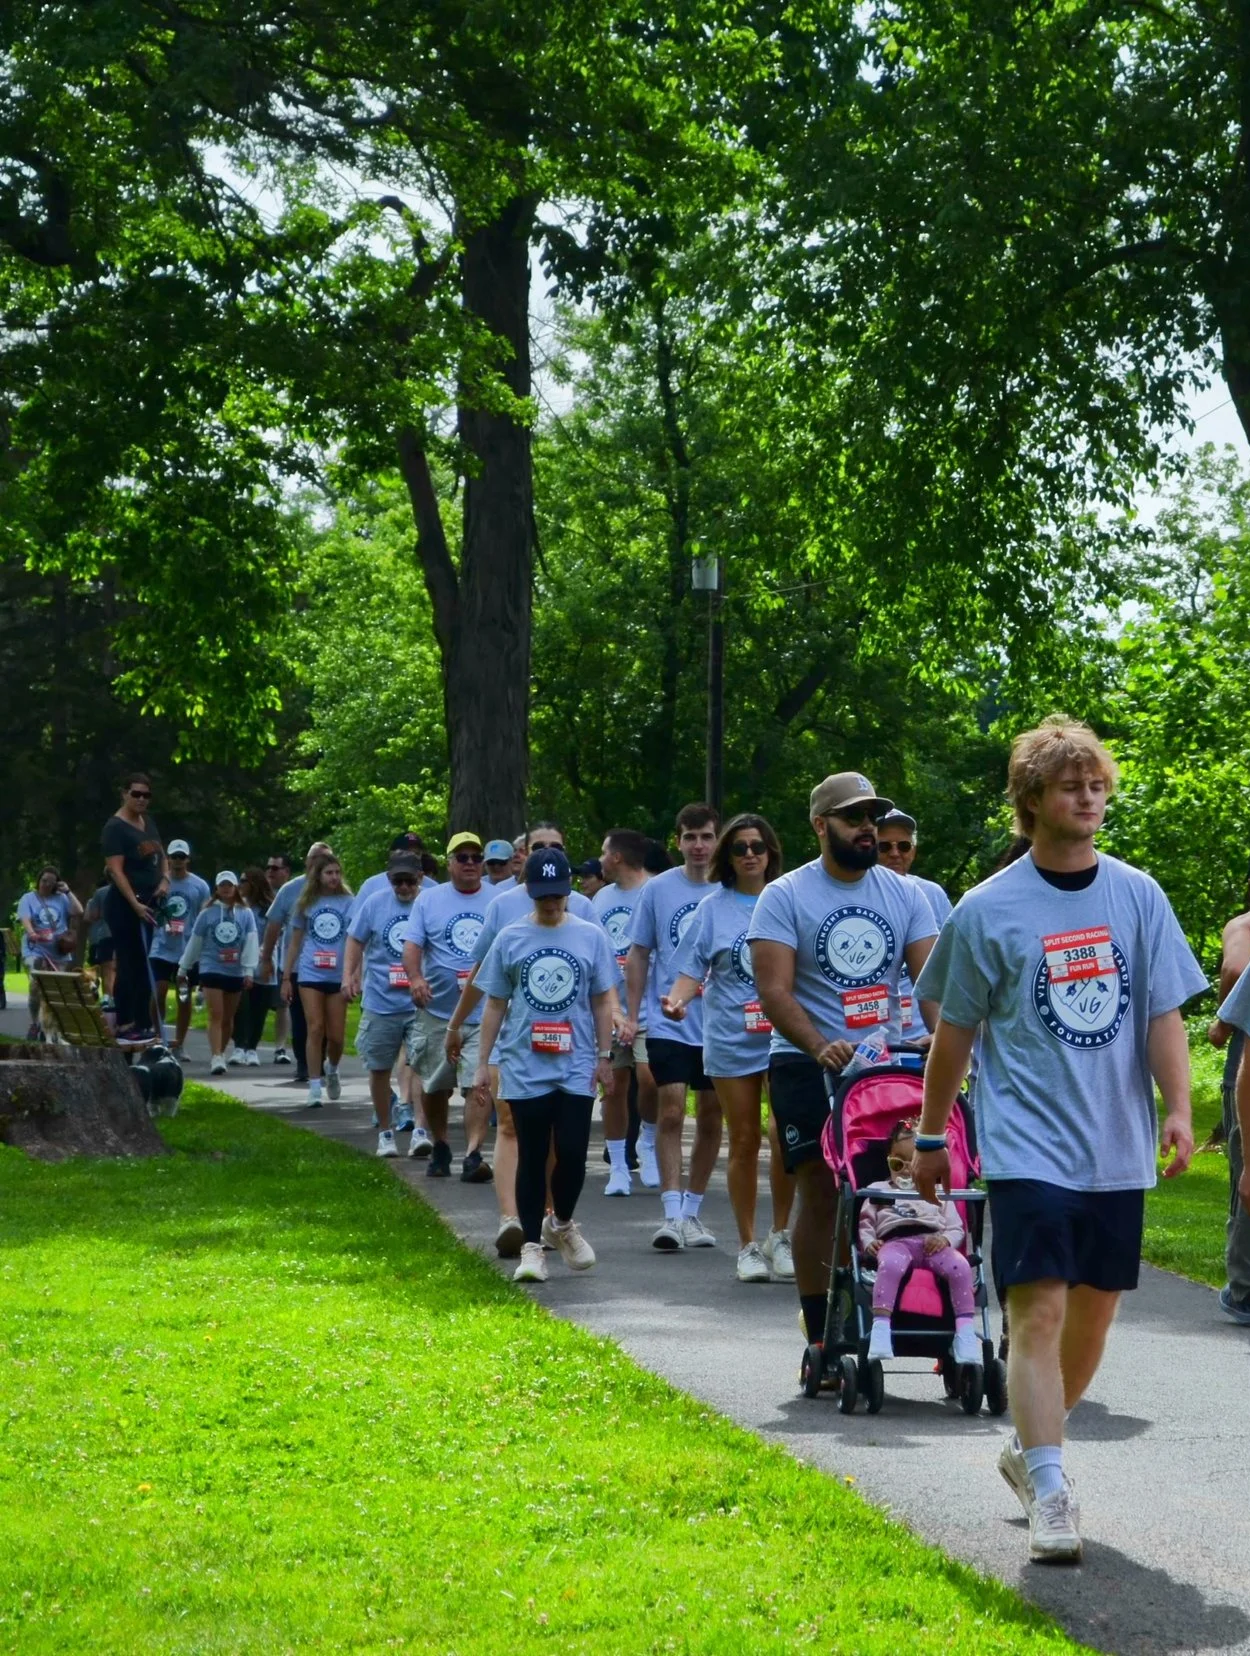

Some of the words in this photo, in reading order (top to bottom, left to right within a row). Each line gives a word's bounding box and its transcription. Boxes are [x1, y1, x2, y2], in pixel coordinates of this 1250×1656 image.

[817, 912, 840, 949] VINCENT
[856, 908, 893, 947] GAGLIARDI
[1044, 939, 1061, 947] SPLIT
[1062, 934, 1086, 943] SECOND
[1086, 930, 1109, 939] RACING
[1063, 946, 1097, 963] 3388
[1038, 967, 1048, 998] VINC
[1113, 952, 1129, 986] IARDI
[857, 1000, 880, 1013] 3458
[1079, 996, 1101, 1014] VG
[1049, 1012, 1122, 1044] FOUNDATION
[542, 1033, 562, 1042] 3461
